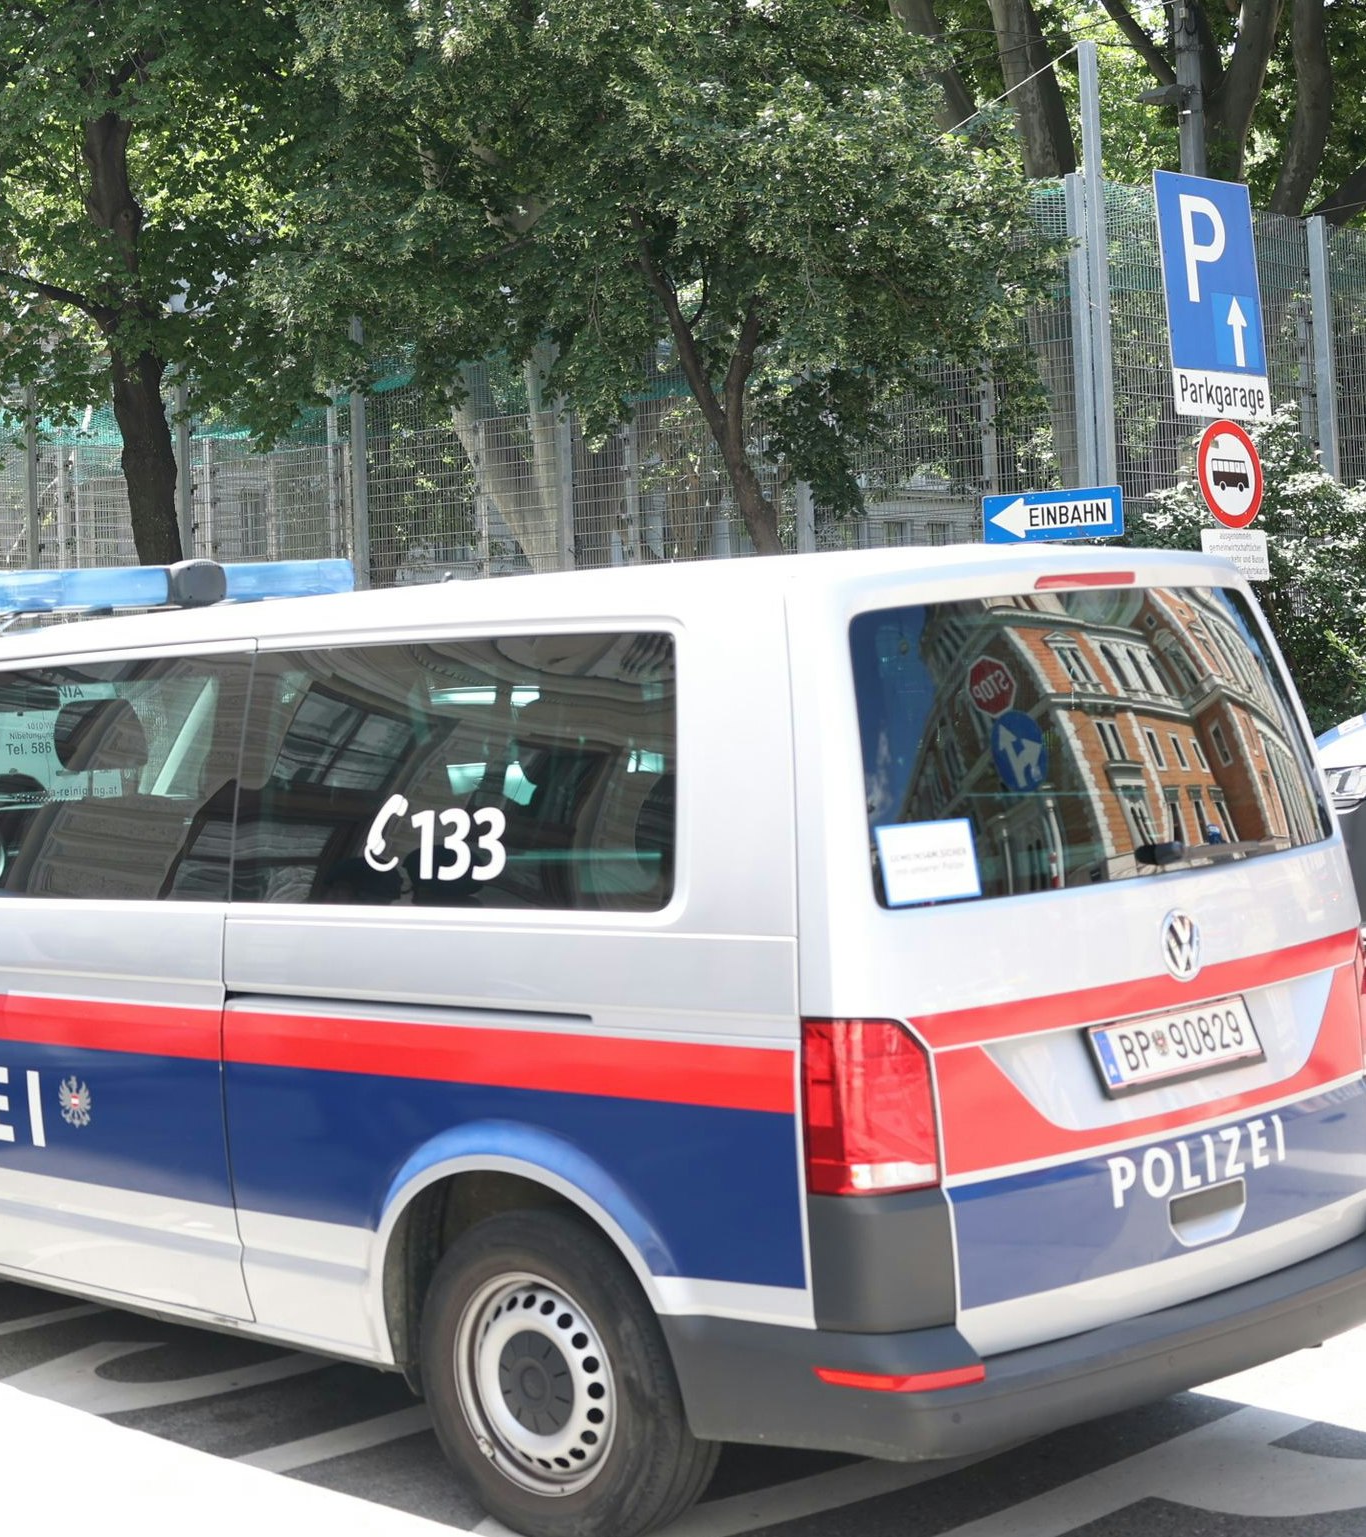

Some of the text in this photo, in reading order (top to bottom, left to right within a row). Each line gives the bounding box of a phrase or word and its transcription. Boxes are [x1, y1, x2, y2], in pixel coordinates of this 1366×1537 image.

[1179, 193, 1226, 303] P
[1179, 373, 1265, 416] Parkgarage
[1029, 502, 1107, 528] EINBAHN
[6, 742, 52, 756] Tel. 586
[410, 806, 507, 882] 133
[1119, 1010, 1244, 1071] BP 90829
[1107, 1114, 1286, 1209] POLIZEI
